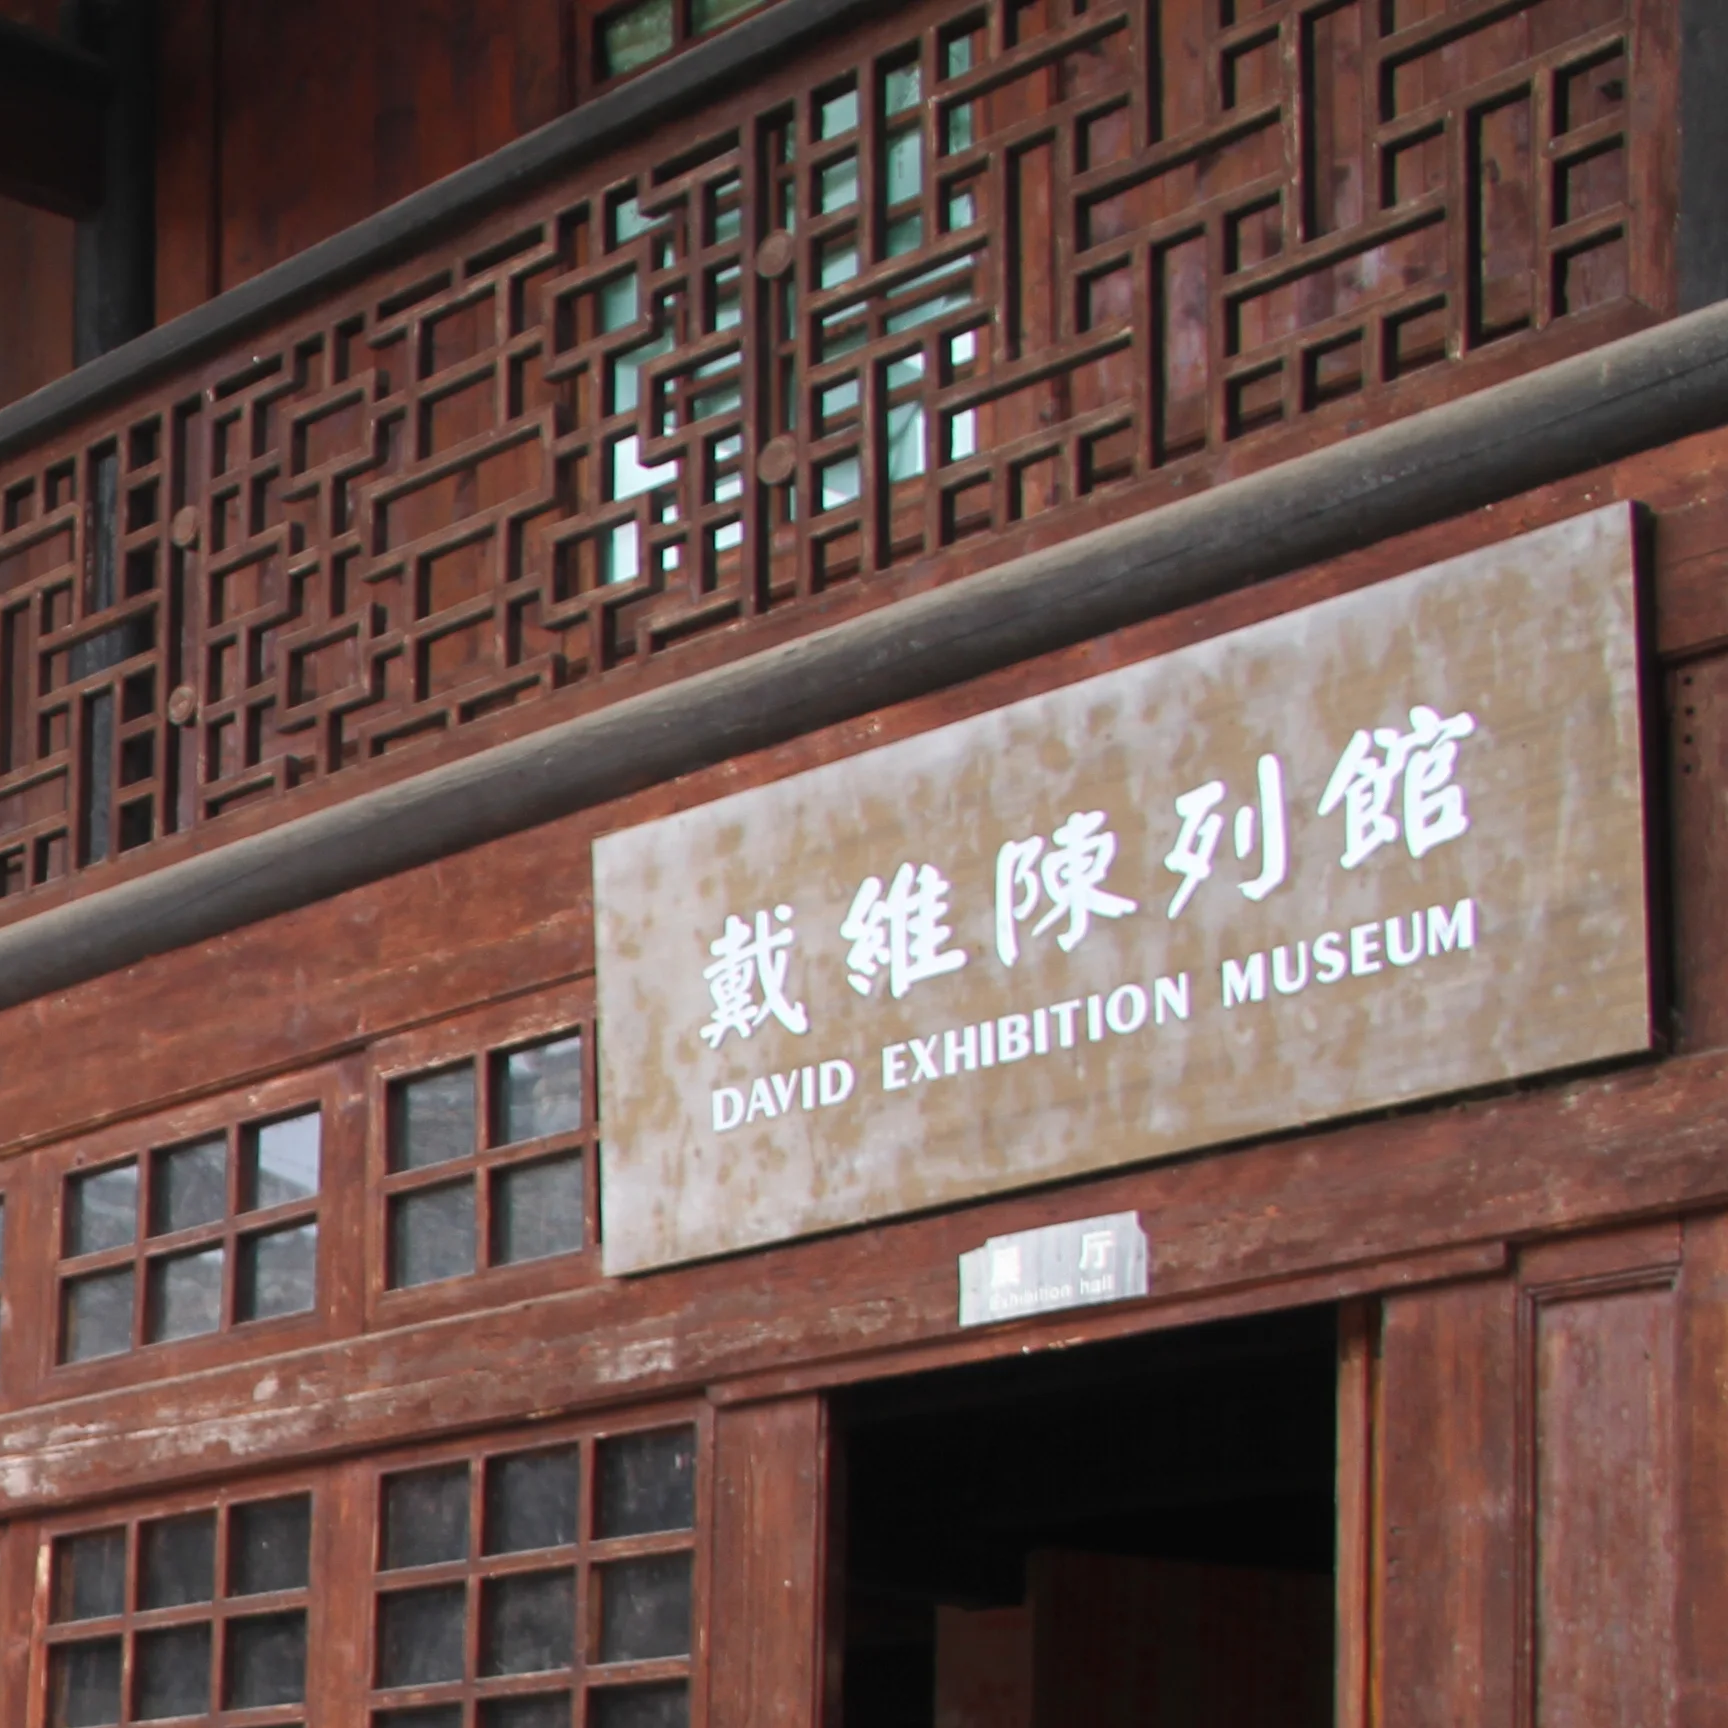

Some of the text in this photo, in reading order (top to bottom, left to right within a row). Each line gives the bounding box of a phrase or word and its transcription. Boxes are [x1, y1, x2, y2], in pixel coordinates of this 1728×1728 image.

[700, 704, 1476, 1049] 戴維陳列館
[712, 898, 1477, 1132] DAVID EXHIBITION MUSEUM
[991, 1230, 1116, 1288] 厅
[1080, 1274, 1115, 1296] hall
